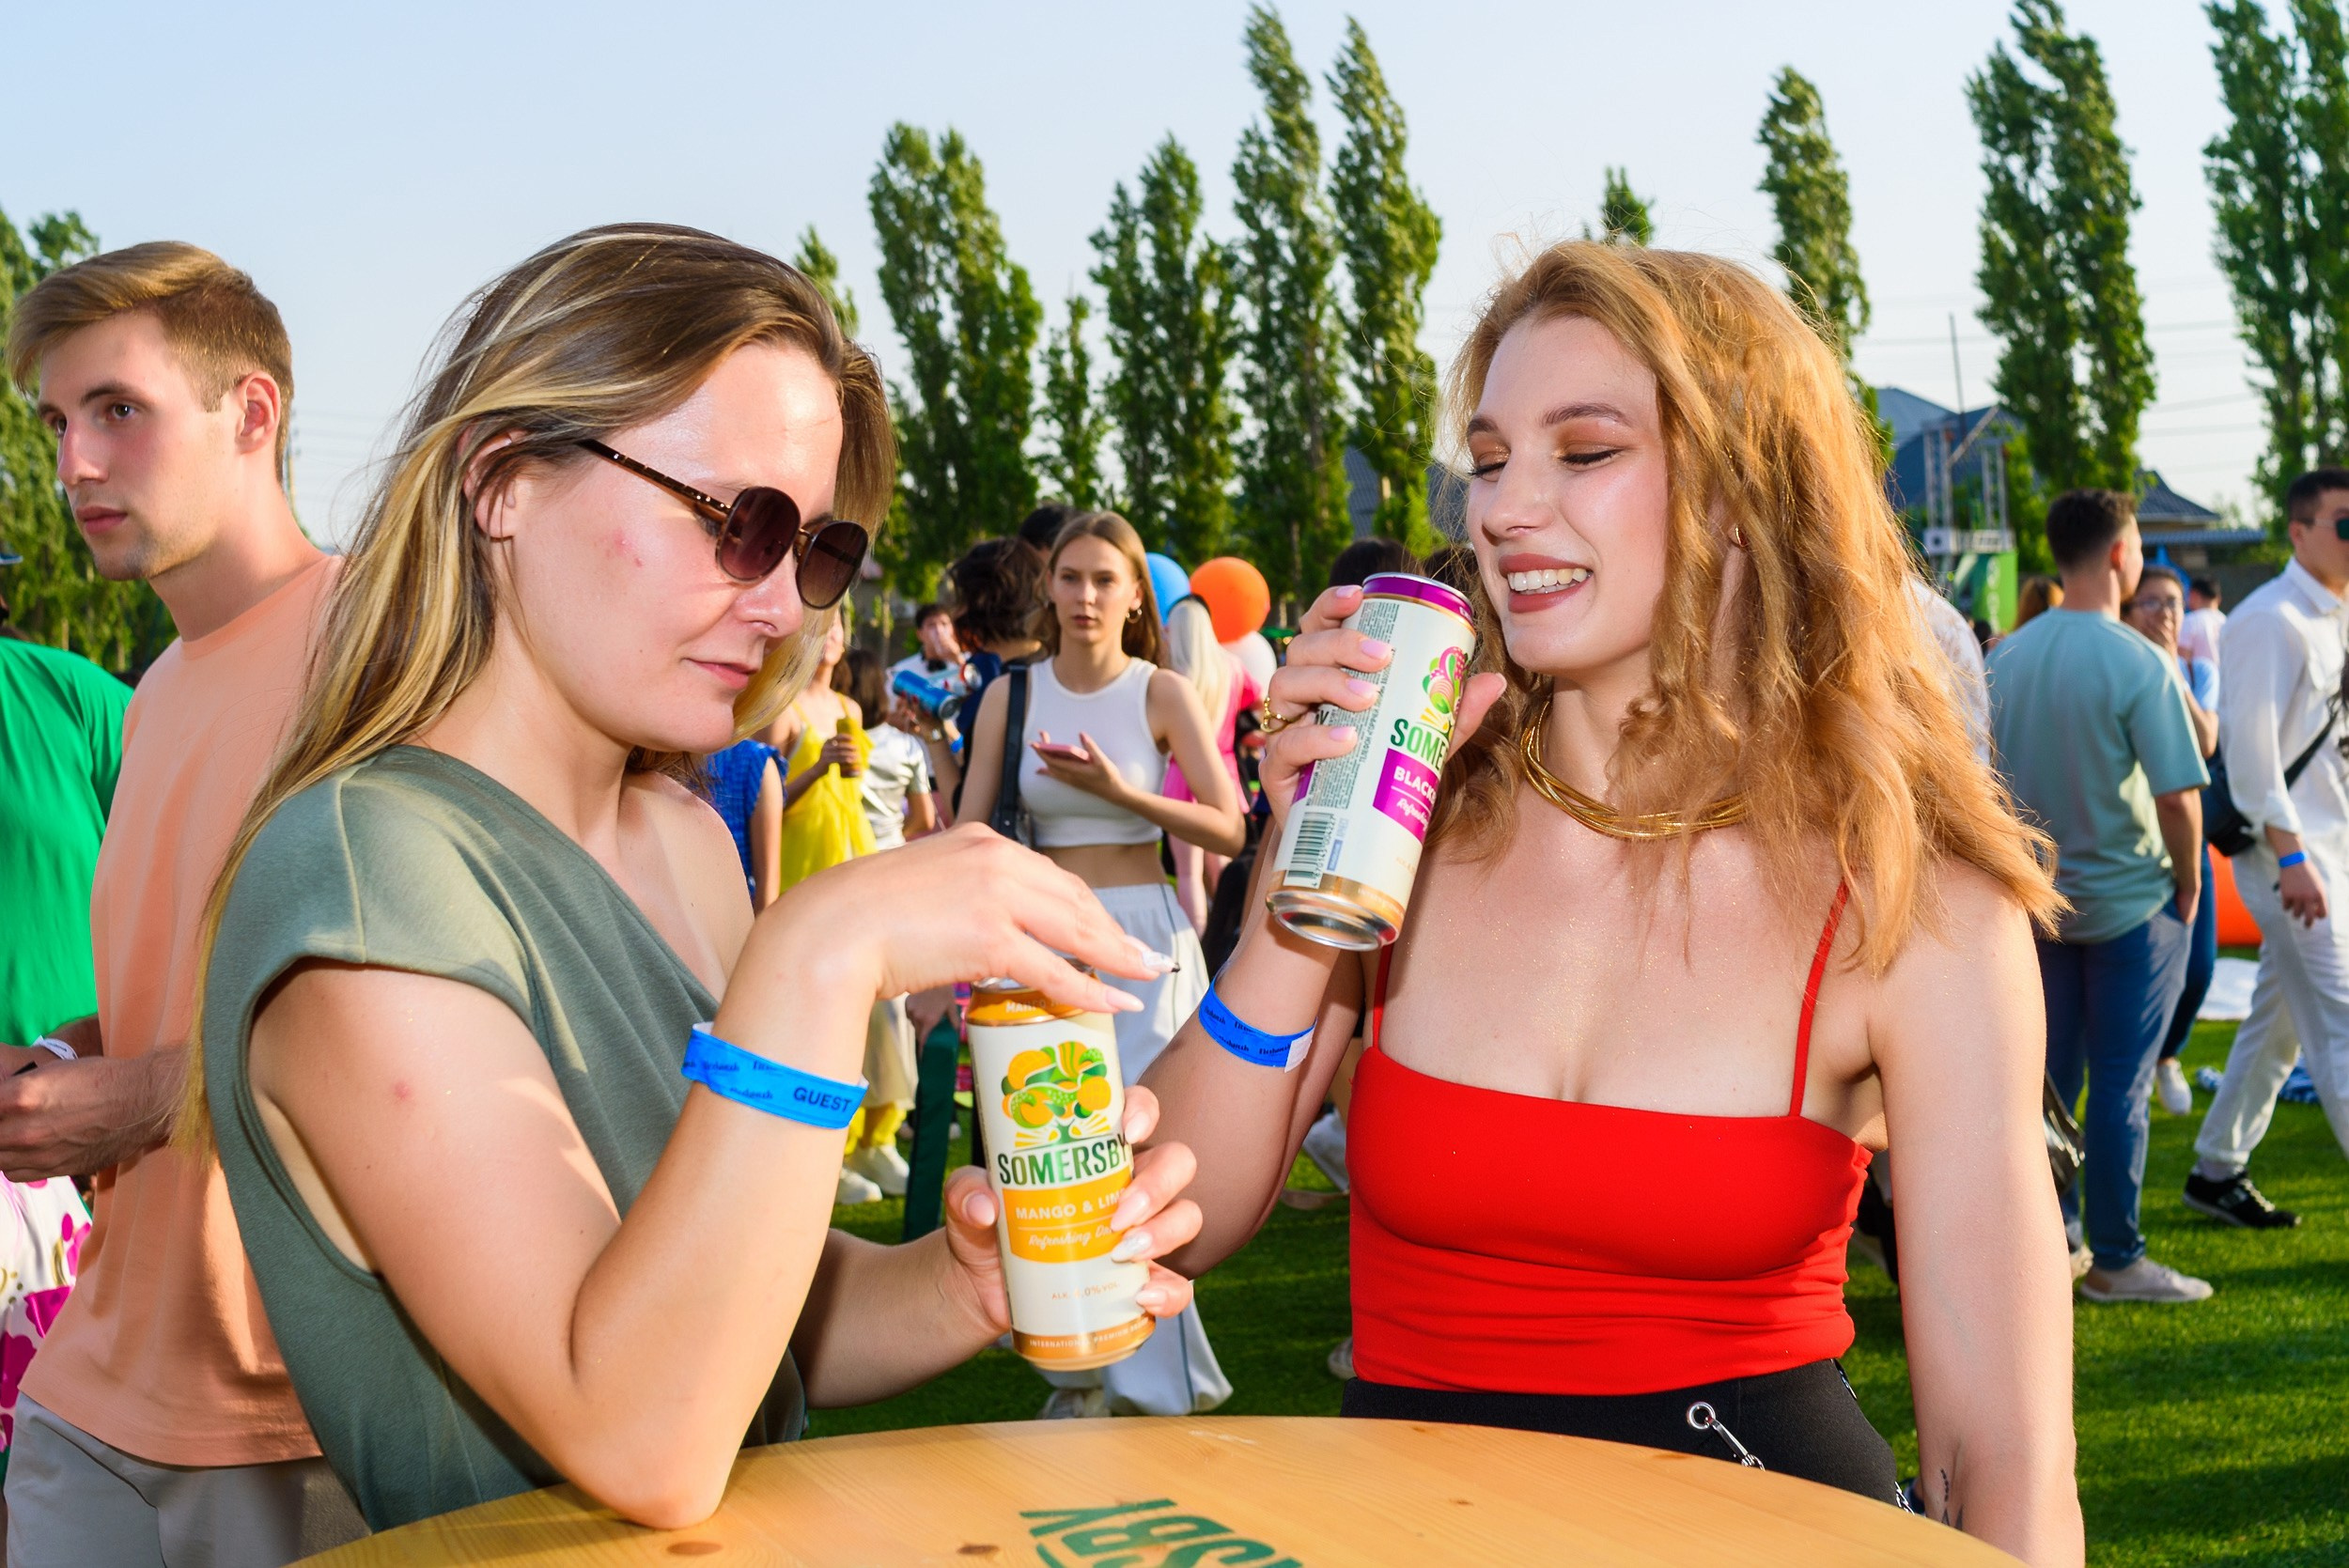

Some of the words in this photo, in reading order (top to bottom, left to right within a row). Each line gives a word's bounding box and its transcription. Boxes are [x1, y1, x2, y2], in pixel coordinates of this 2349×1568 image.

[1391, 718, 1446, 770] SOME
[793, 1086, 852, 1113] GUEST
[998, 1133, 1127, 1185] SOMERSBY
[1016, 1203, 1077, 1219] MANGO
[1082, 1200, 1094, 1213] &
[1028, 1231, 1091, 1250] Refreshing
[1019, 1498, 1304, 1568] SBY
